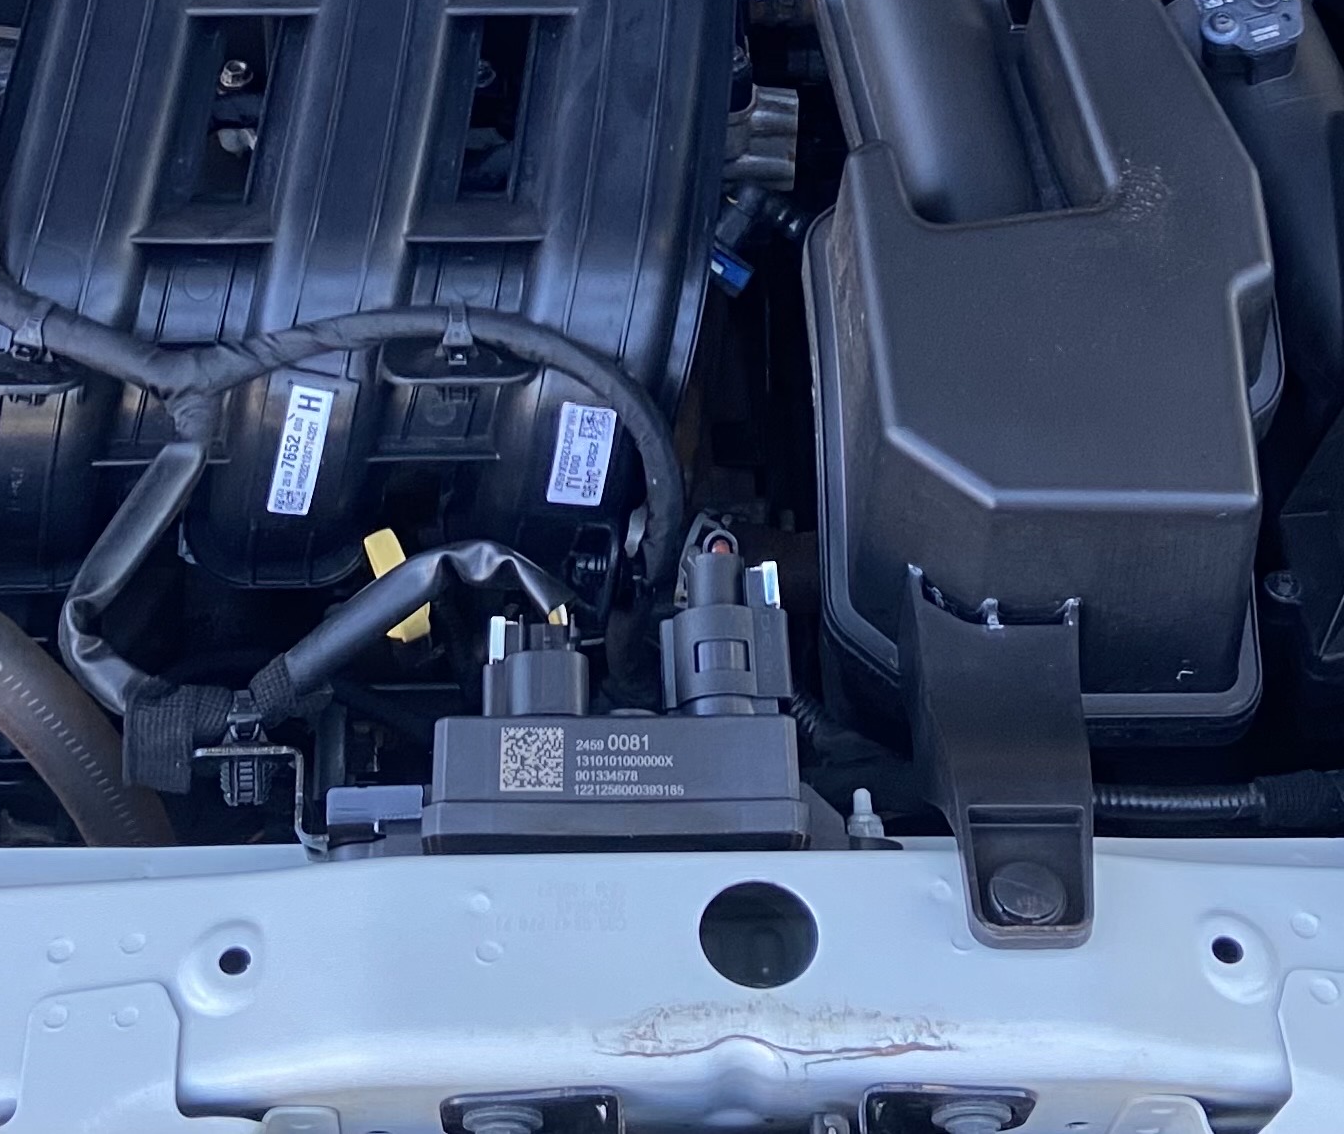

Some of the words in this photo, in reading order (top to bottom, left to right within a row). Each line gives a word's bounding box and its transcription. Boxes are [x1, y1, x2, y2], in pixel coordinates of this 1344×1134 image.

[297, 394, 322, 412] H
[281, 434, 301, 469] 7652
[575, 739, 605, 752] 2459
[607, 734, 649, 751] 0081
[575, 755, 674, 767] 1310101000000X
